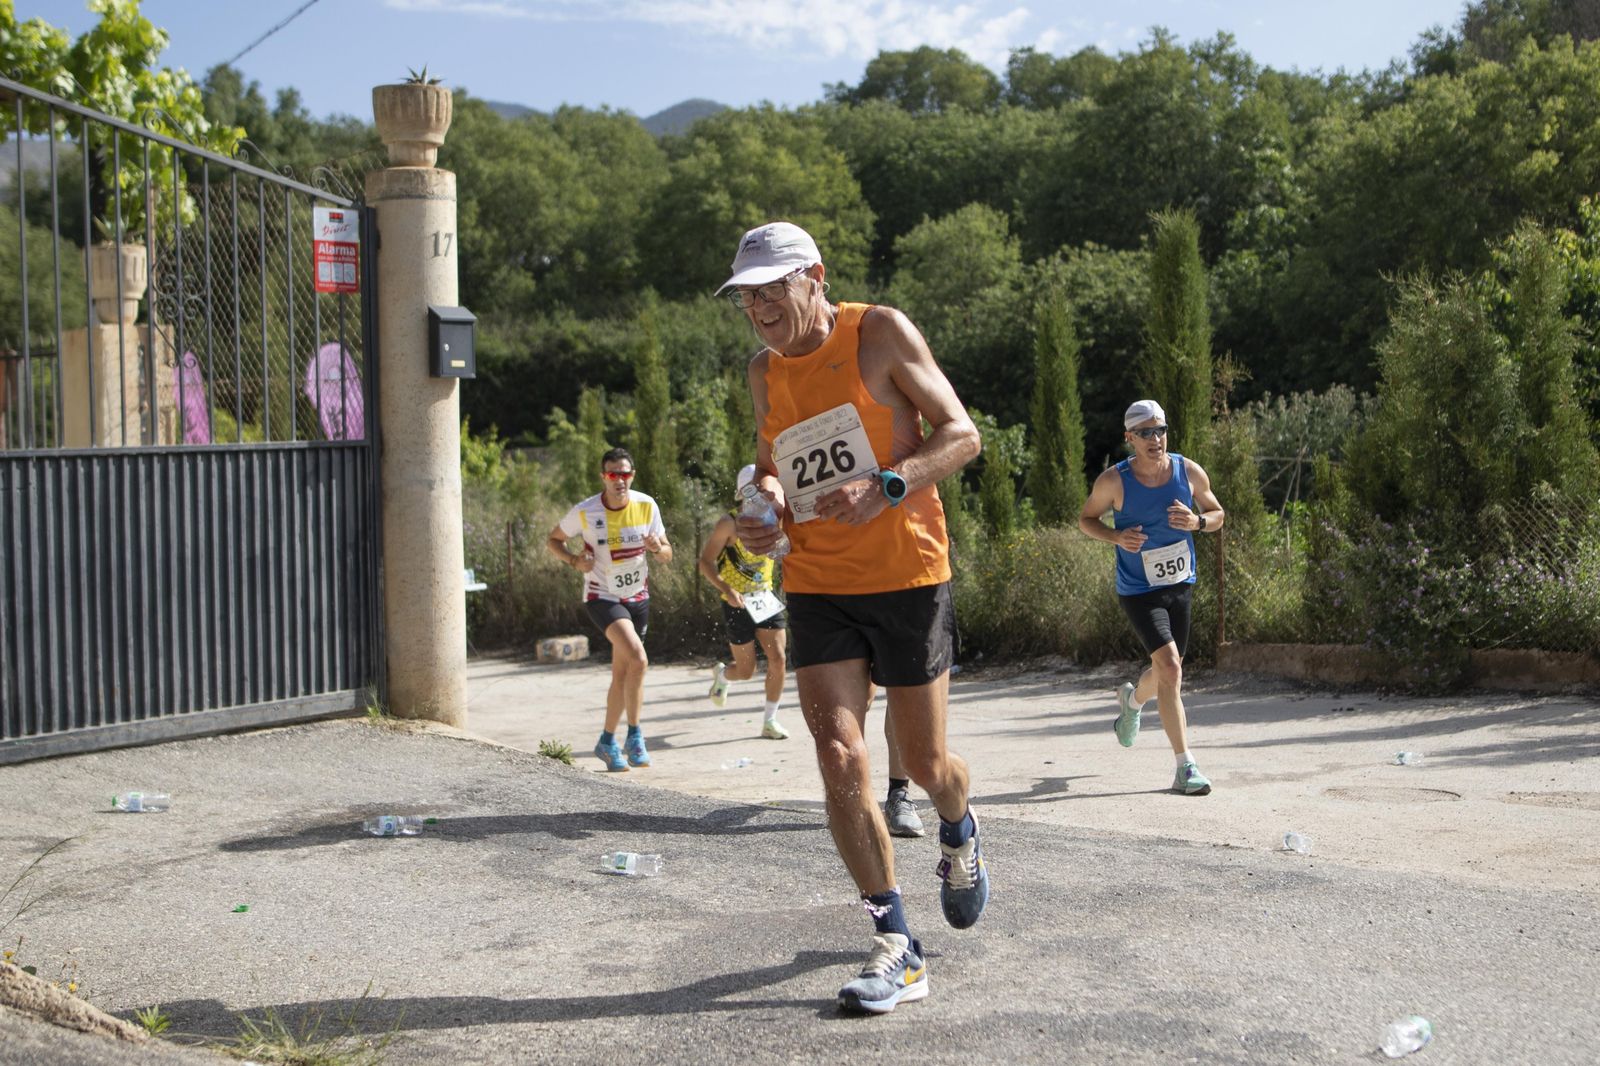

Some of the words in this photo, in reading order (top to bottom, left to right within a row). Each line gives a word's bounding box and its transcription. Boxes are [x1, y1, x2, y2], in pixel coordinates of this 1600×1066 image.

[318, 242, 356, 256] Alarma
[431, 230, 454, 258] 17
[791, 439, 856, 490] 226
[614, 570, 641, 588] 382
[1153, 556, 1185, 579] 350
